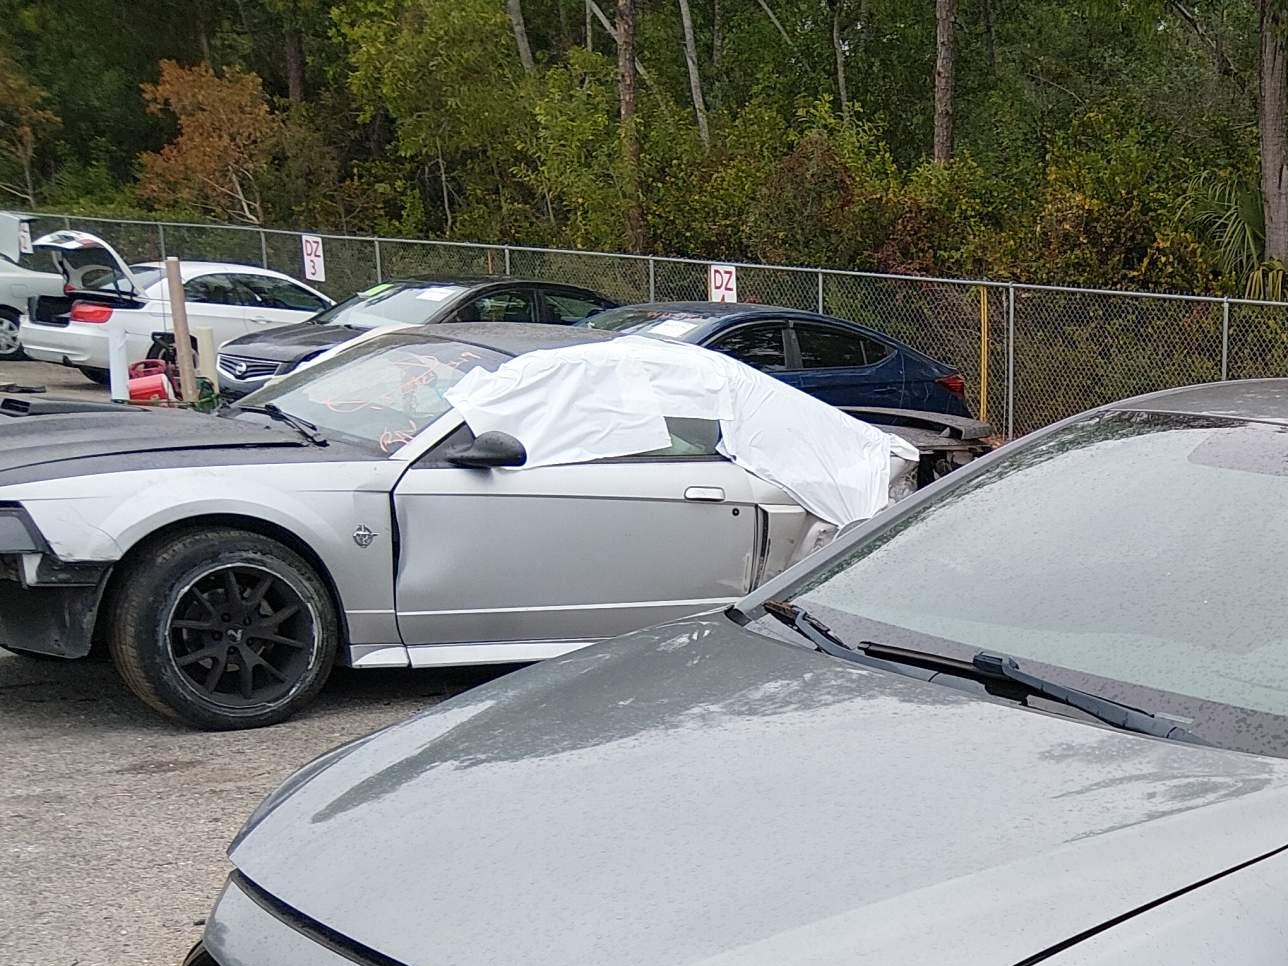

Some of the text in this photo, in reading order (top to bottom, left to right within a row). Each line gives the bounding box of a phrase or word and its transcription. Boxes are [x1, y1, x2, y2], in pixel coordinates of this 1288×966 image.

[304, 239, 321, 258] DZ
[310, 259, 317, 276] 3
[714, 269, 734, 291] DZ
